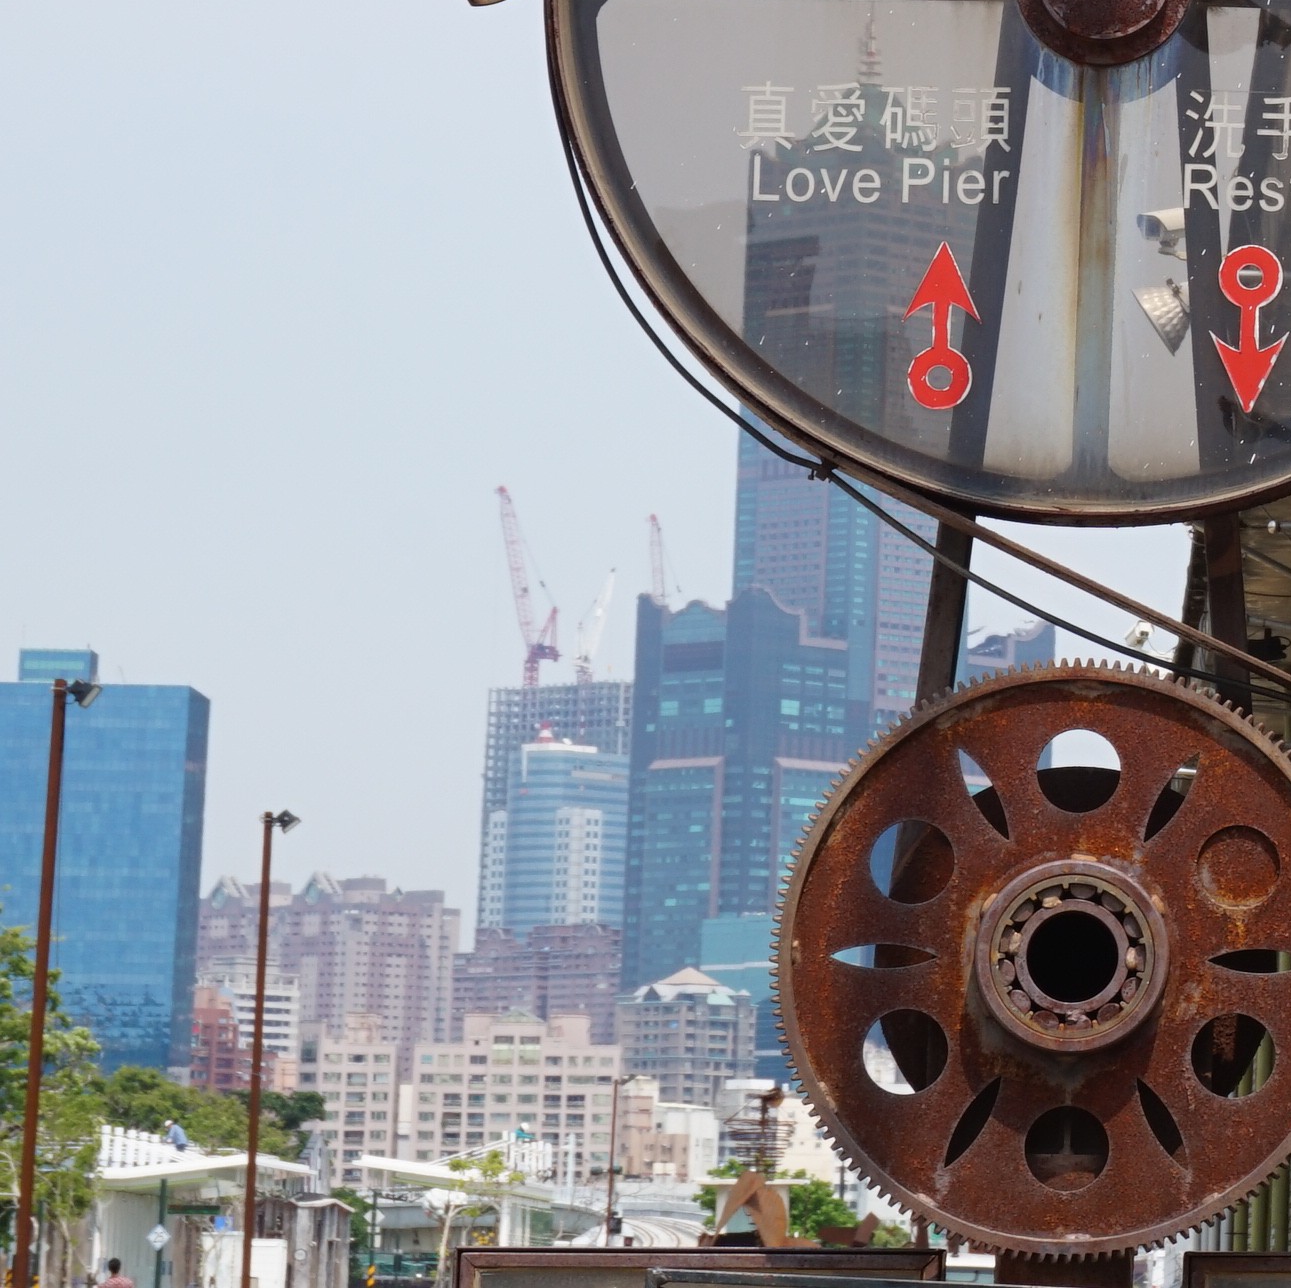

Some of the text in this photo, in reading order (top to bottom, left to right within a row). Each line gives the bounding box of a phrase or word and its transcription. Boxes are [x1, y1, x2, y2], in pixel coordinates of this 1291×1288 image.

[737, 80, 1012, 153] 真愛碼頭
[752, 153, 1011, 205] Love Pier
